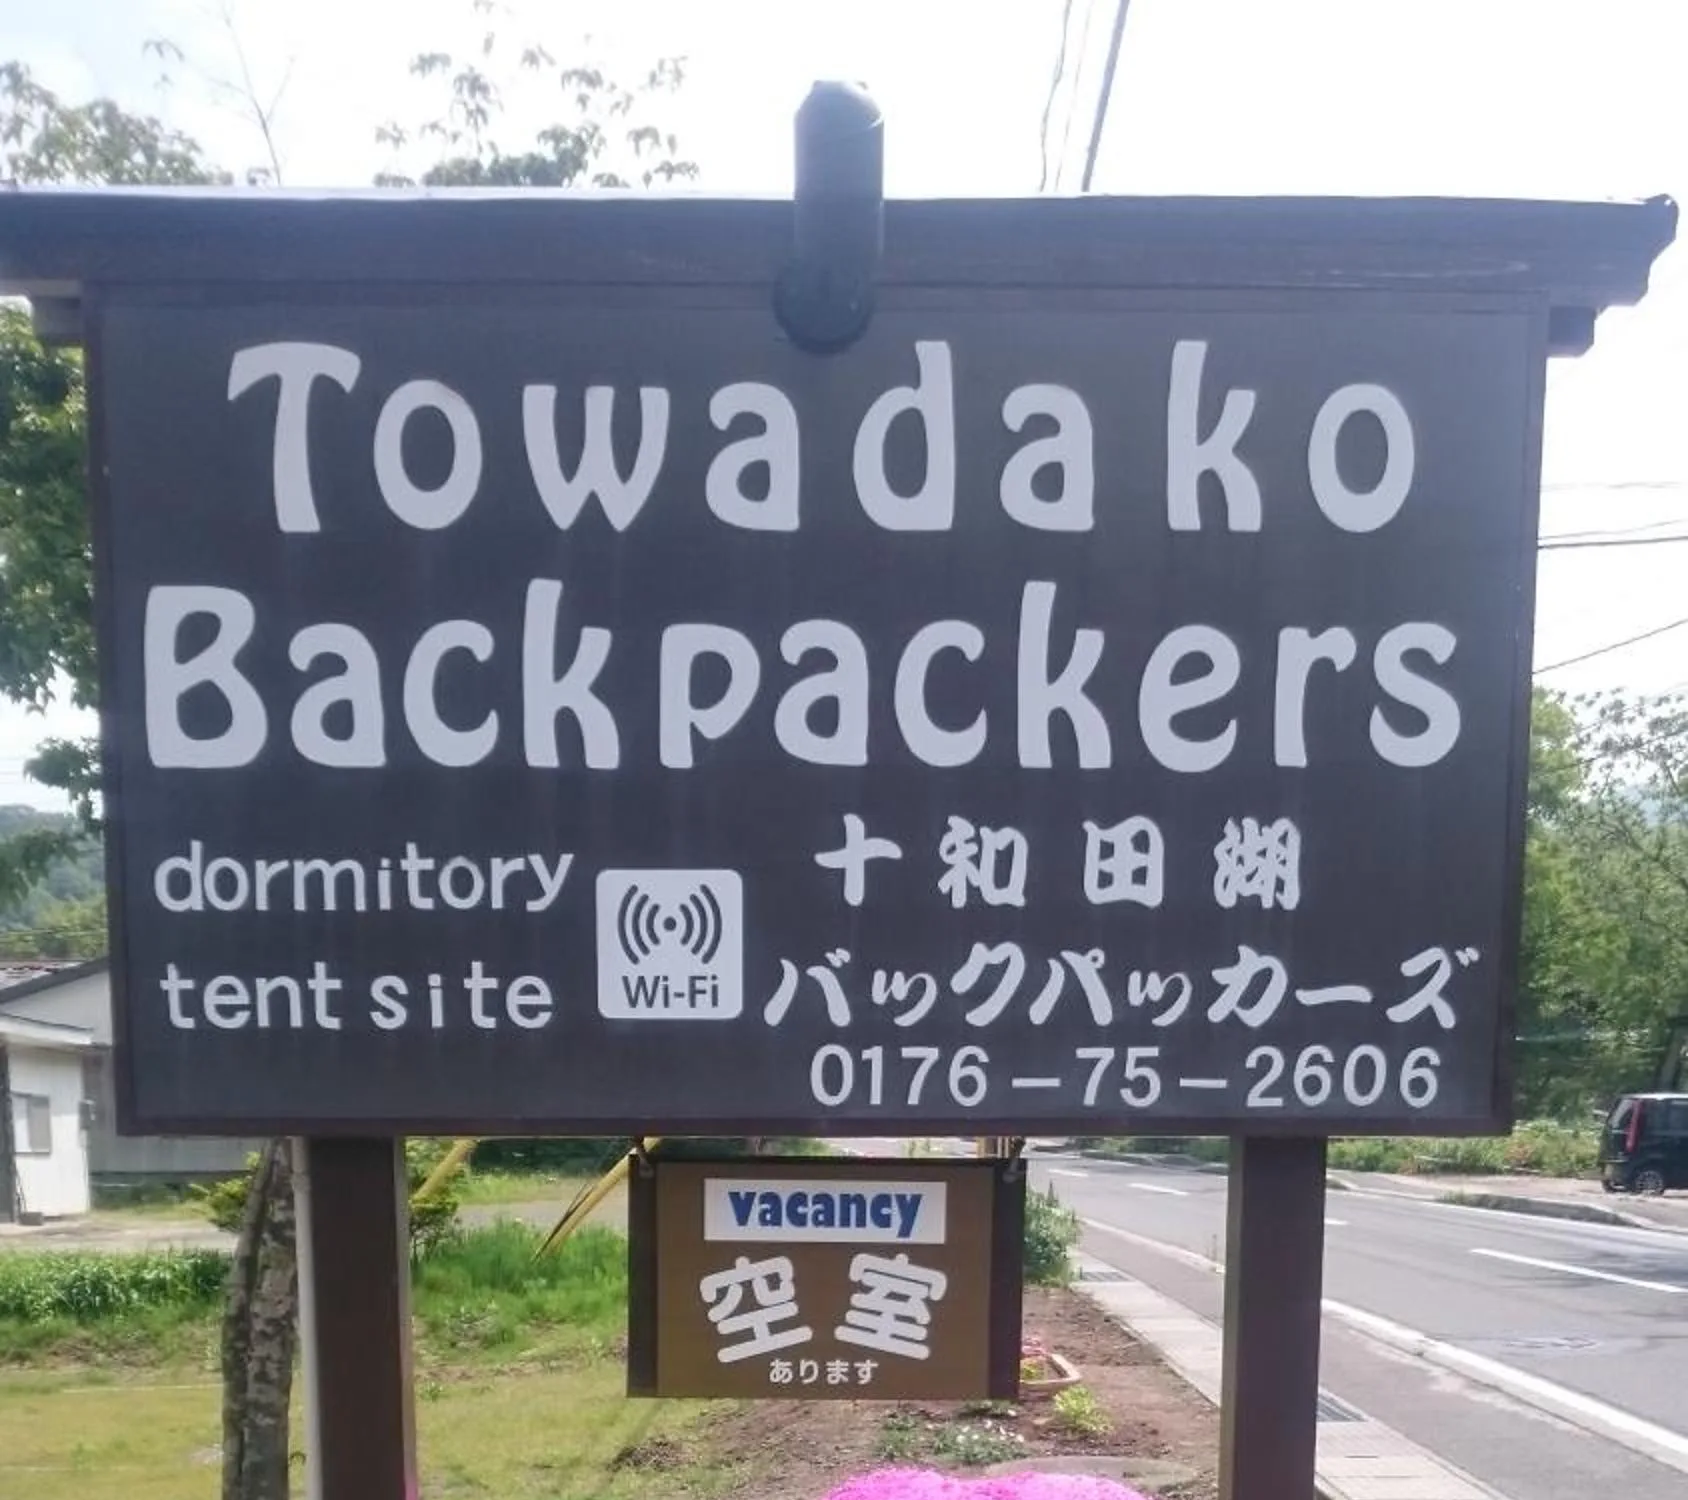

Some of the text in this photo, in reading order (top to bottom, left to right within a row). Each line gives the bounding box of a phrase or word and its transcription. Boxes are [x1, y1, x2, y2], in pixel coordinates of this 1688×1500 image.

[227, 338, 1417, 534] Towadako
[143, 577, 1463, 774] Backpackers
[153, 839, 575, 913] dormitory
[814, 812, 1303, 911] 十和田湖
[158, 960, 554, 1031] tent site
[622, 974, 720, 1010] Wi-Fi
[762, 941, 1481, 1030] バックパッカーズ
[727, 1189, 923, 1239] vacancy
[699, 1252, 949, 1365] 空室
[768, 1358, 880, 1387] あります
